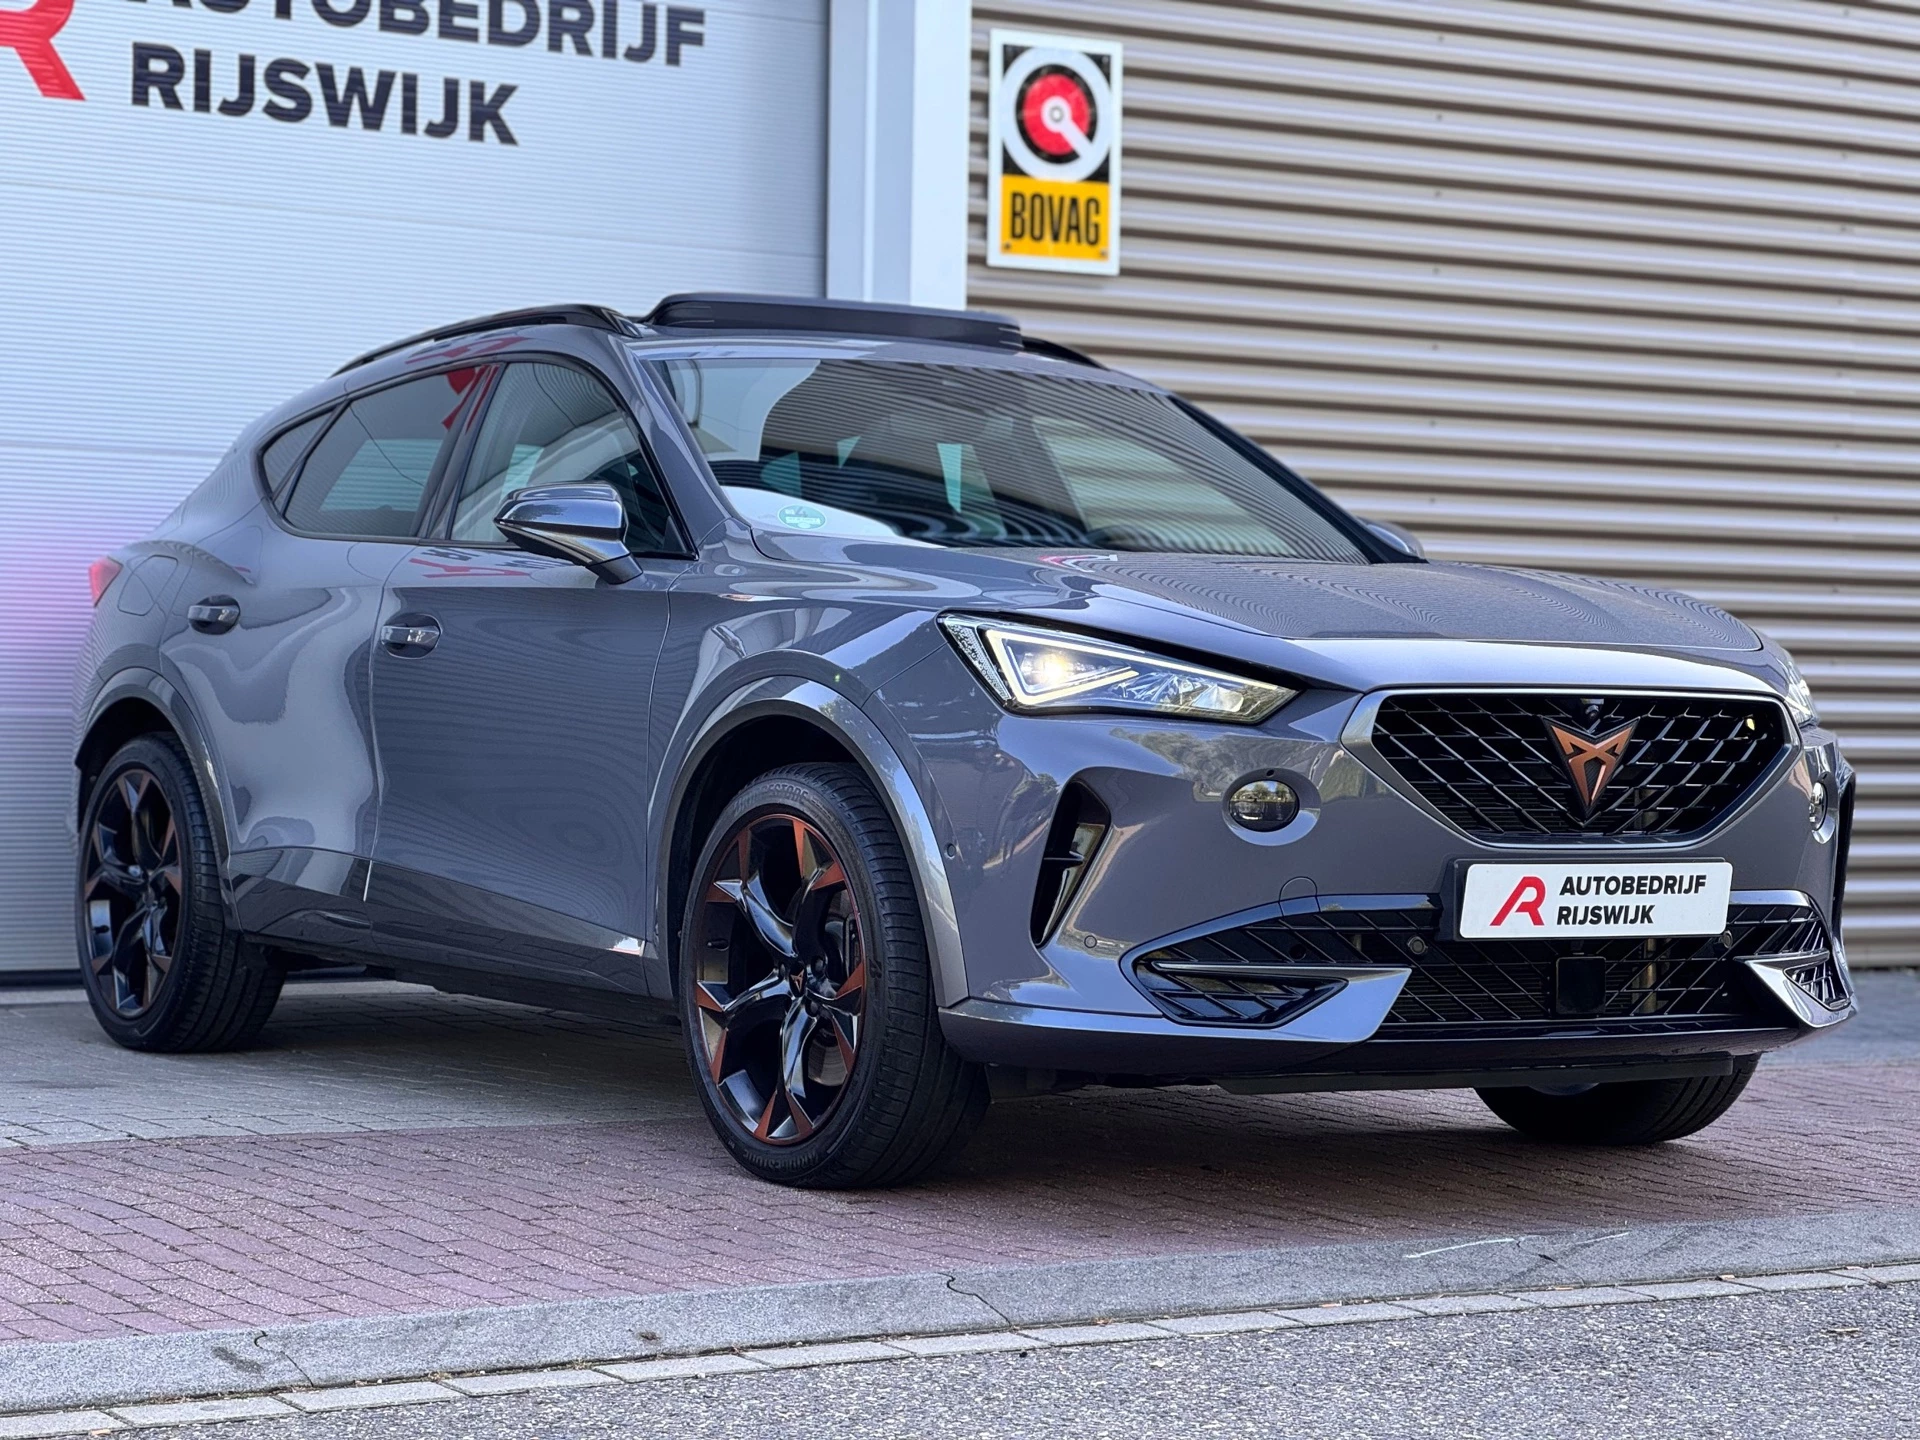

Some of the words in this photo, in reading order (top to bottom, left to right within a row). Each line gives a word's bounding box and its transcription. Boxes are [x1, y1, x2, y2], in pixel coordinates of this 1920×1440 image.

[126, 0, 705, 66] BEDRIJF
[131, 41, 519, 146] RIJSWIJK
[1010, 191, 1100, 246] BOVAG
[1559, 875, 1707, 896] AUTOBEDRIJF
[1557, 905, 1655, 926] RIJSWIJK
